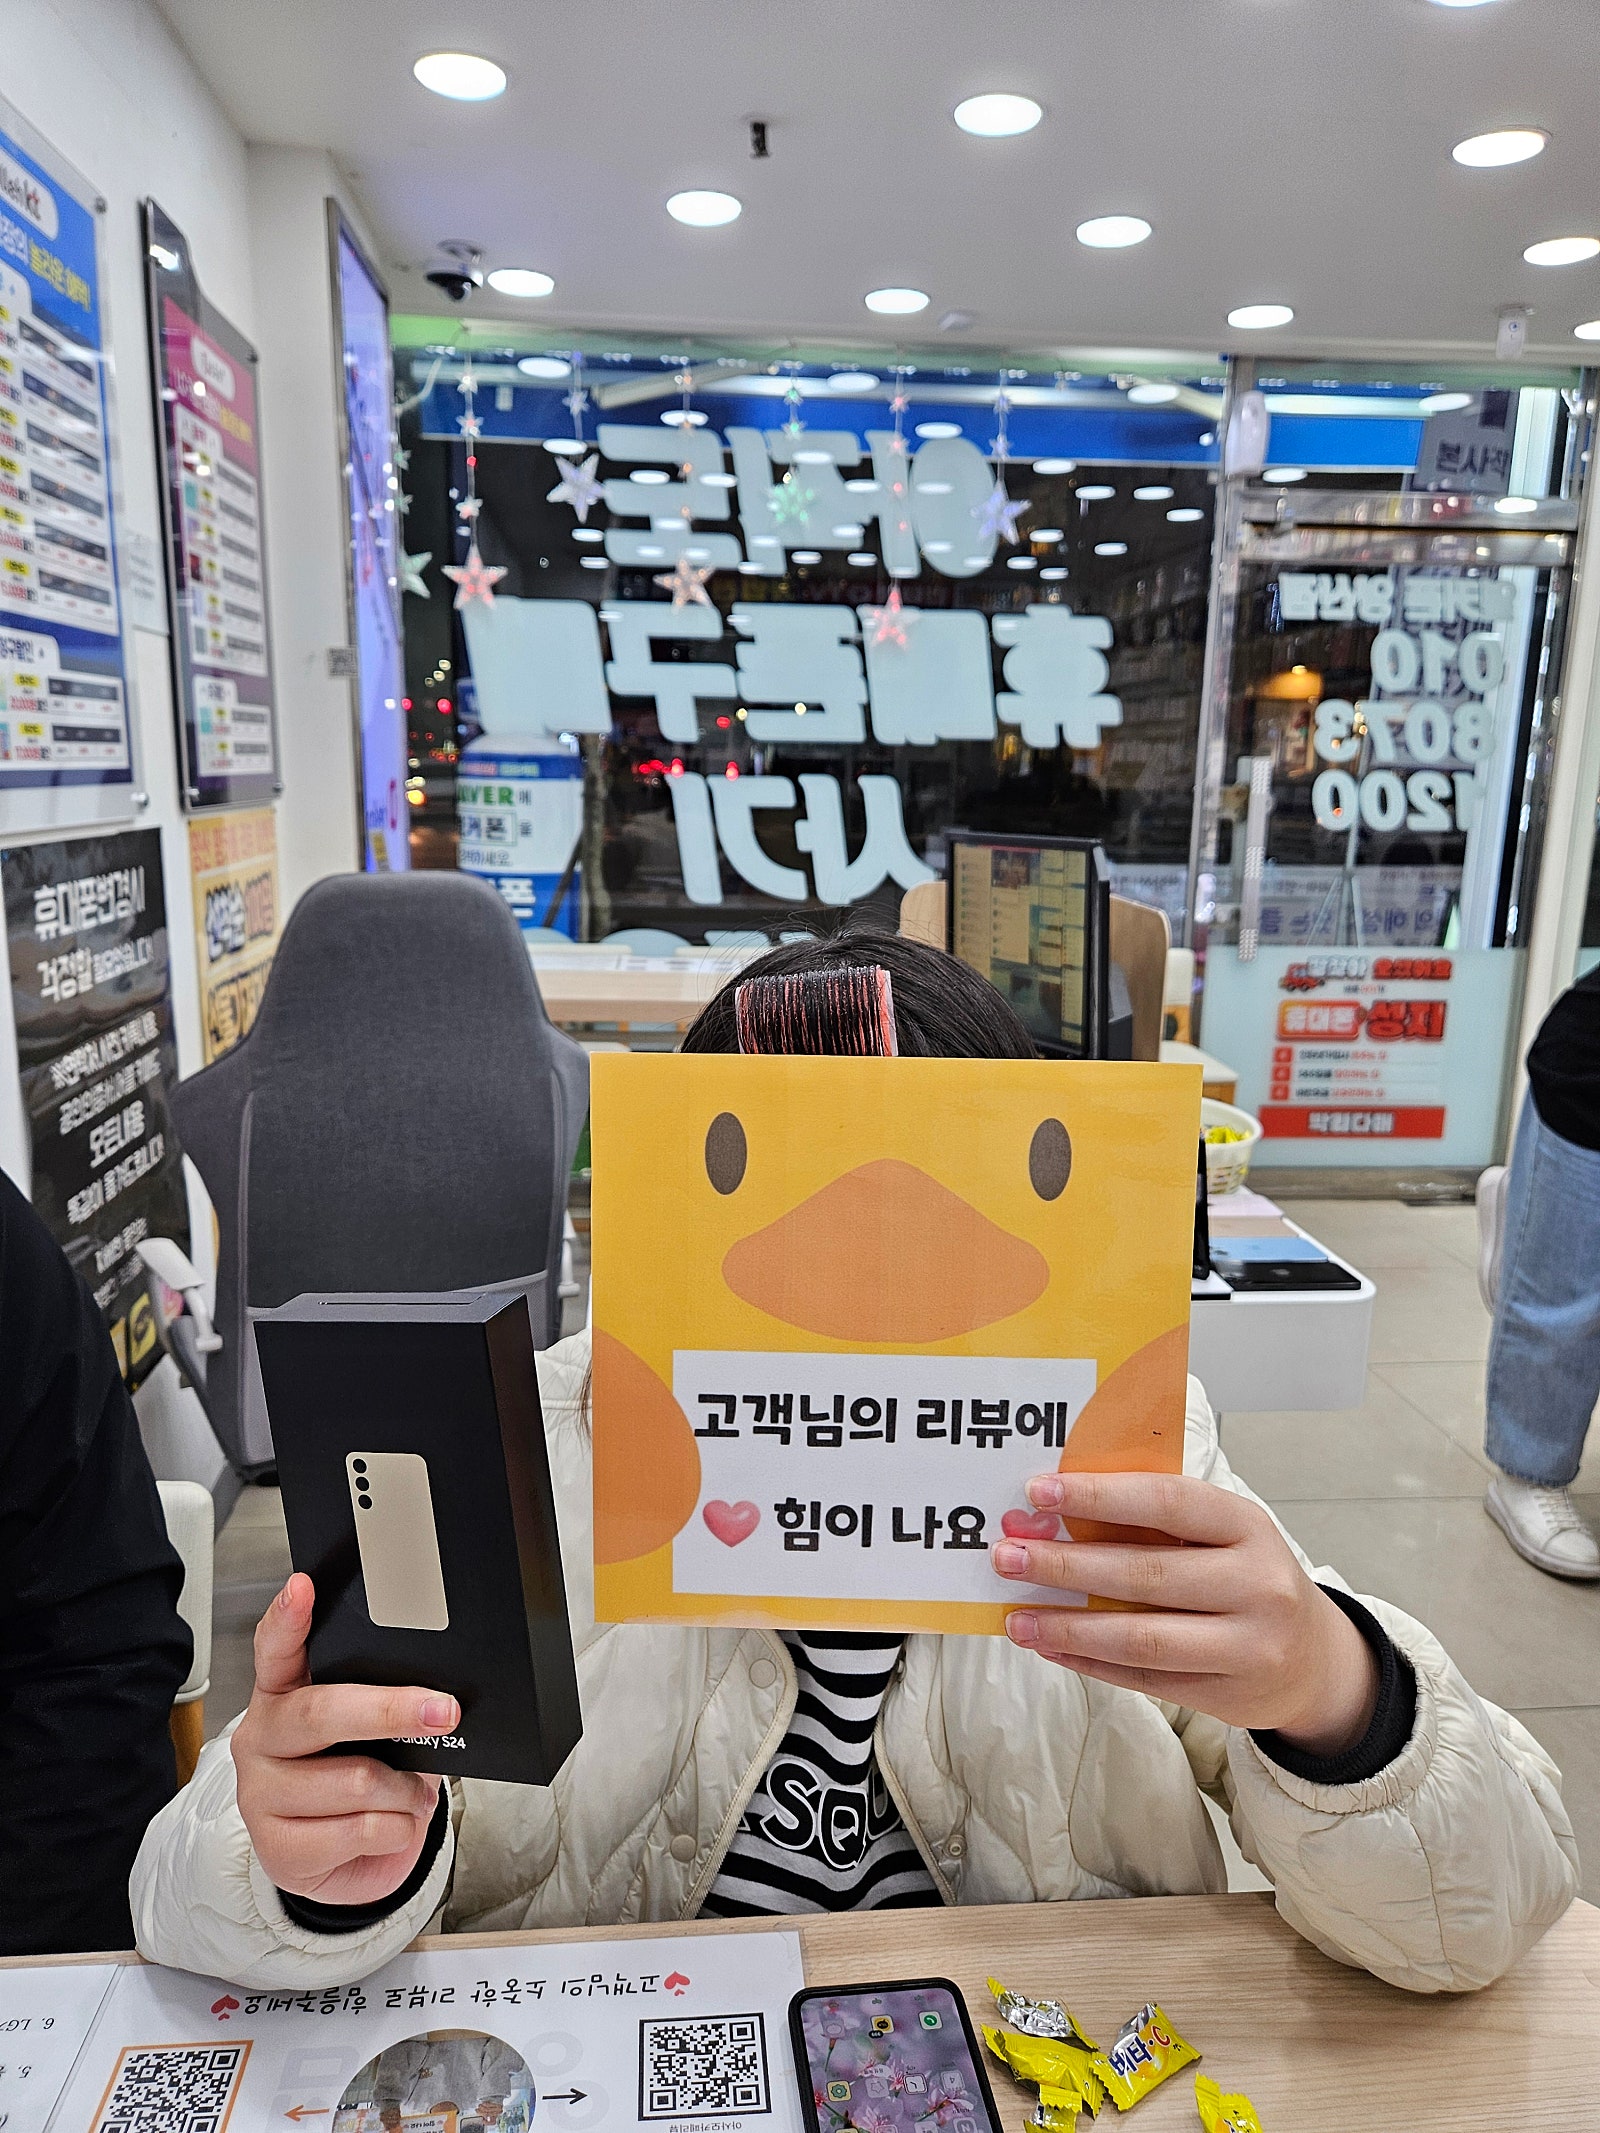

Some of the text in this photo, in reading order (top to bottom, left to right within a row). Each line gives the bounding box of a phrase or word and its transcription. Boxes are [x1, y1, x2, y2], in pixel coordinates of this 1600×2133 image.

[694, 1392, 1069, 1450] 고객님의 리뷰에
[774, 1497, 990, 1551] 힘이 나요
[392, 1736, 466, 1749] alaxy S24
[245, 1973, 660, 2015] 고객님의 소중한 리뷰로 힘을주세요
[41, 2017, 55, 2030] 6.
[18, 2065, 32, 2079] 5.
